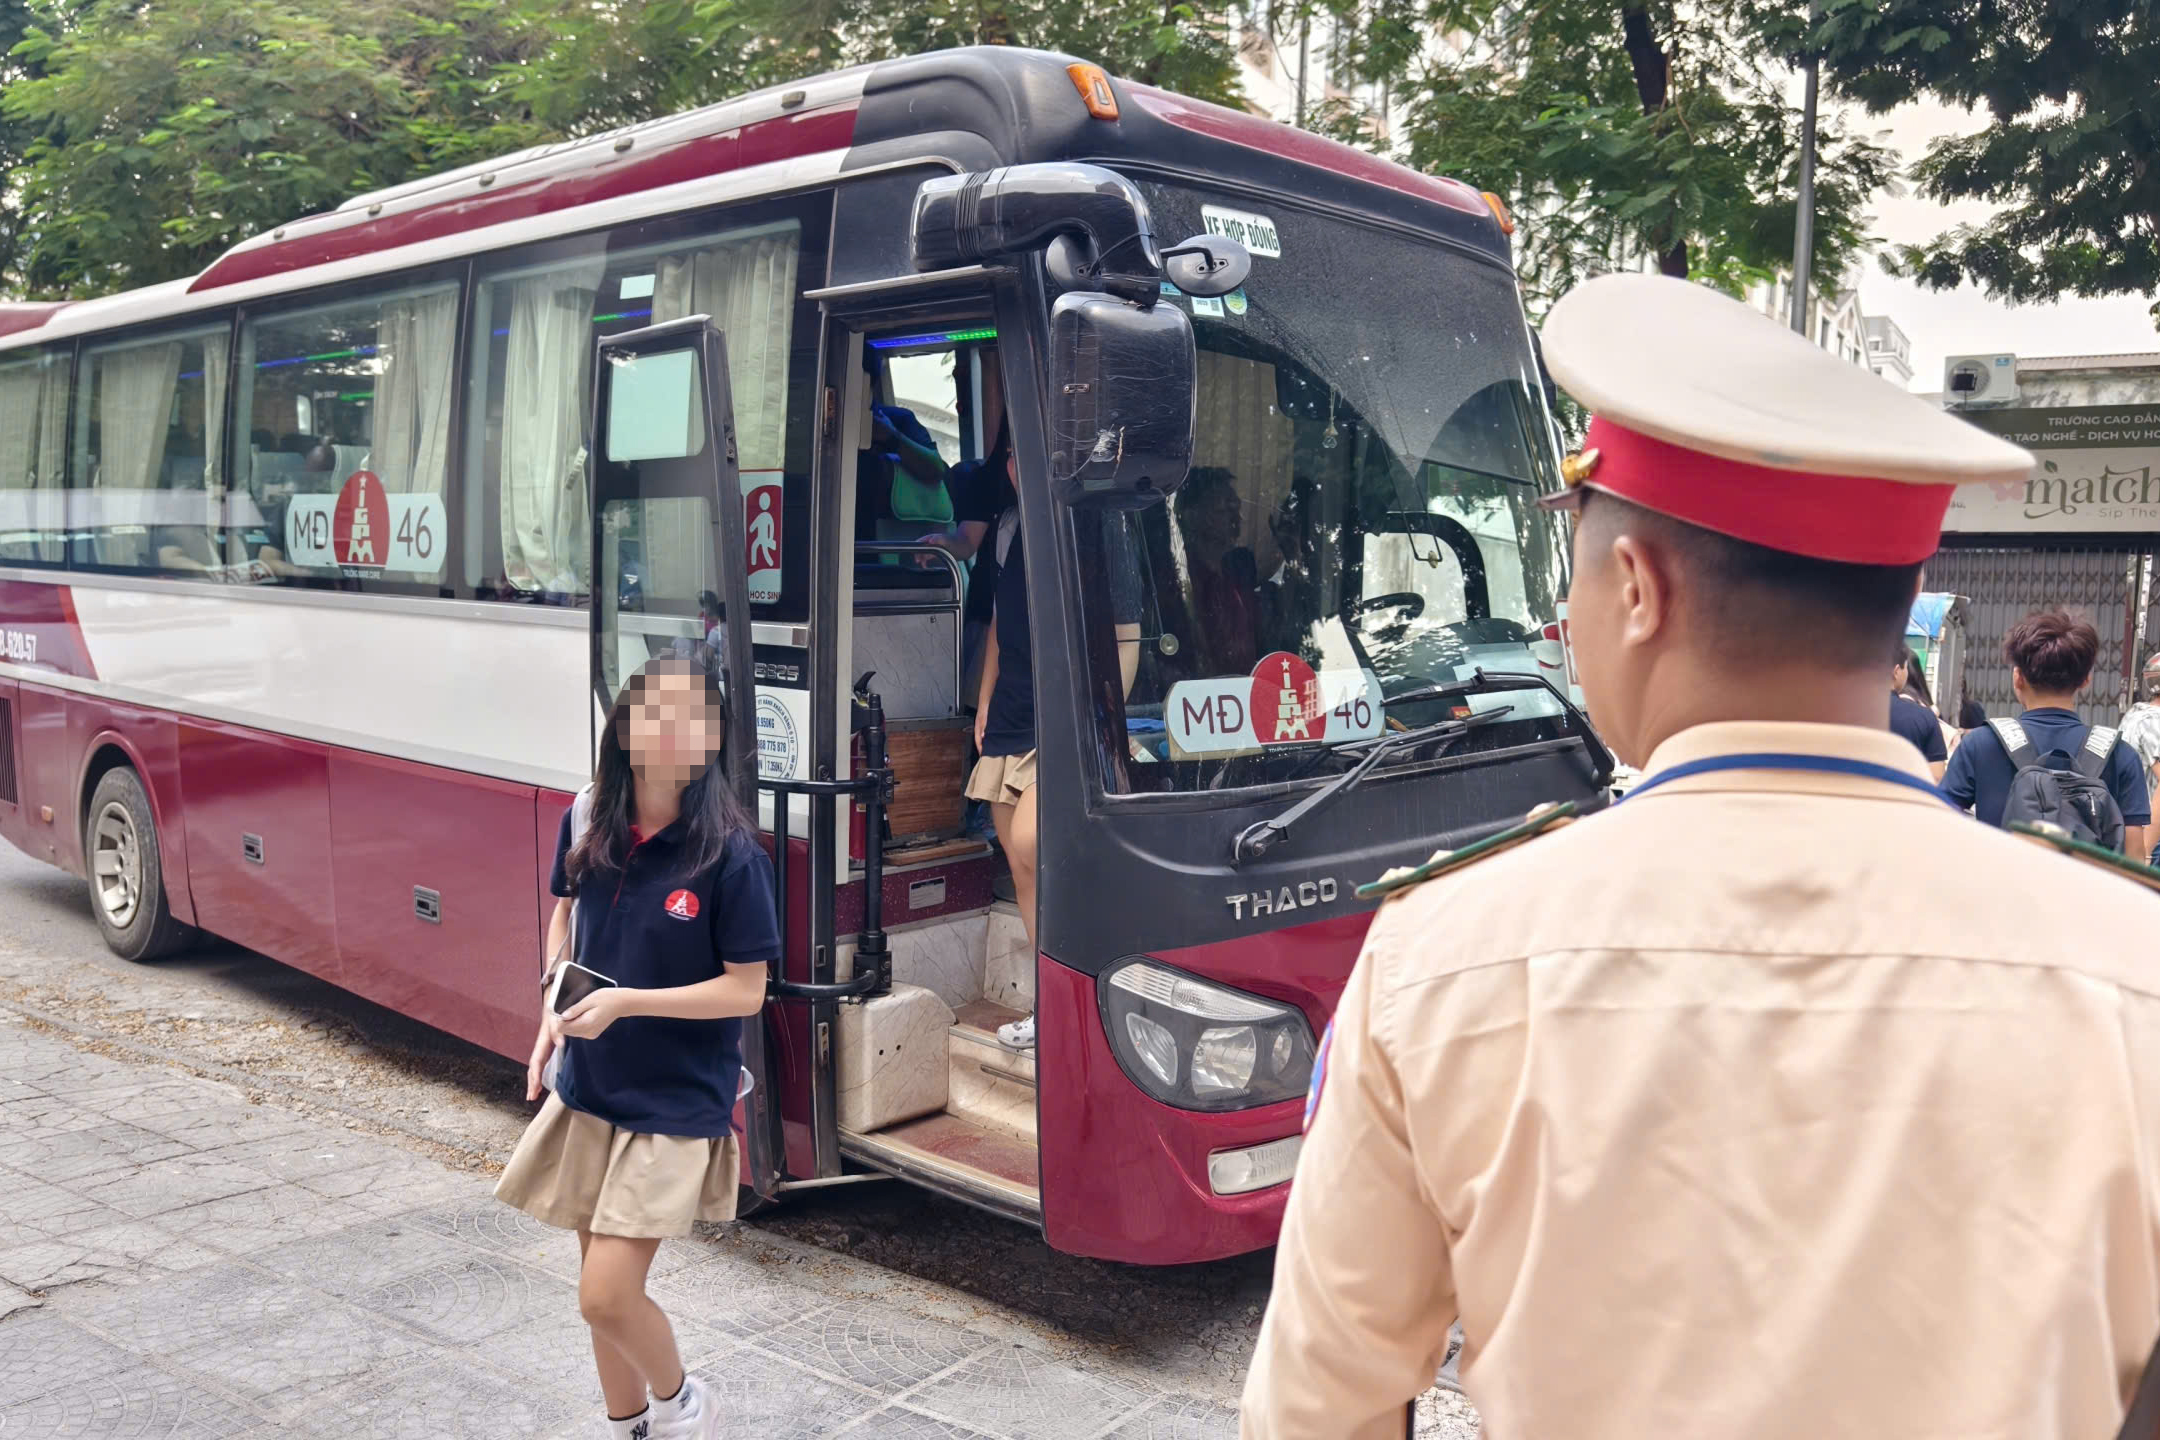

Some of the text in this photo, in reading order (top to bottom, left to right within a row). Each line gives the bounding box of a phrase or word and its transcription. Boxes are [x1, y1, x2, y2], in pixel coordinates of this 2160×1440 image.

[2103, 415, 2131, 425] CAO
[2014, 432, 2039, 444] TẠO
[2088, 431, 2119, 443] DỊCH
[2122, 430, 2140, 441] VỤ
[2099, 507, 2123, 521] Sip
[294, 505, 432, 559] MĐ 46
[767, 591, 781, 600] SIN
[1182, 686, 1371, 736] MĐ 46
[767, 740, 776, 752] 775
[1225, 877, 1338, 920] THACO
